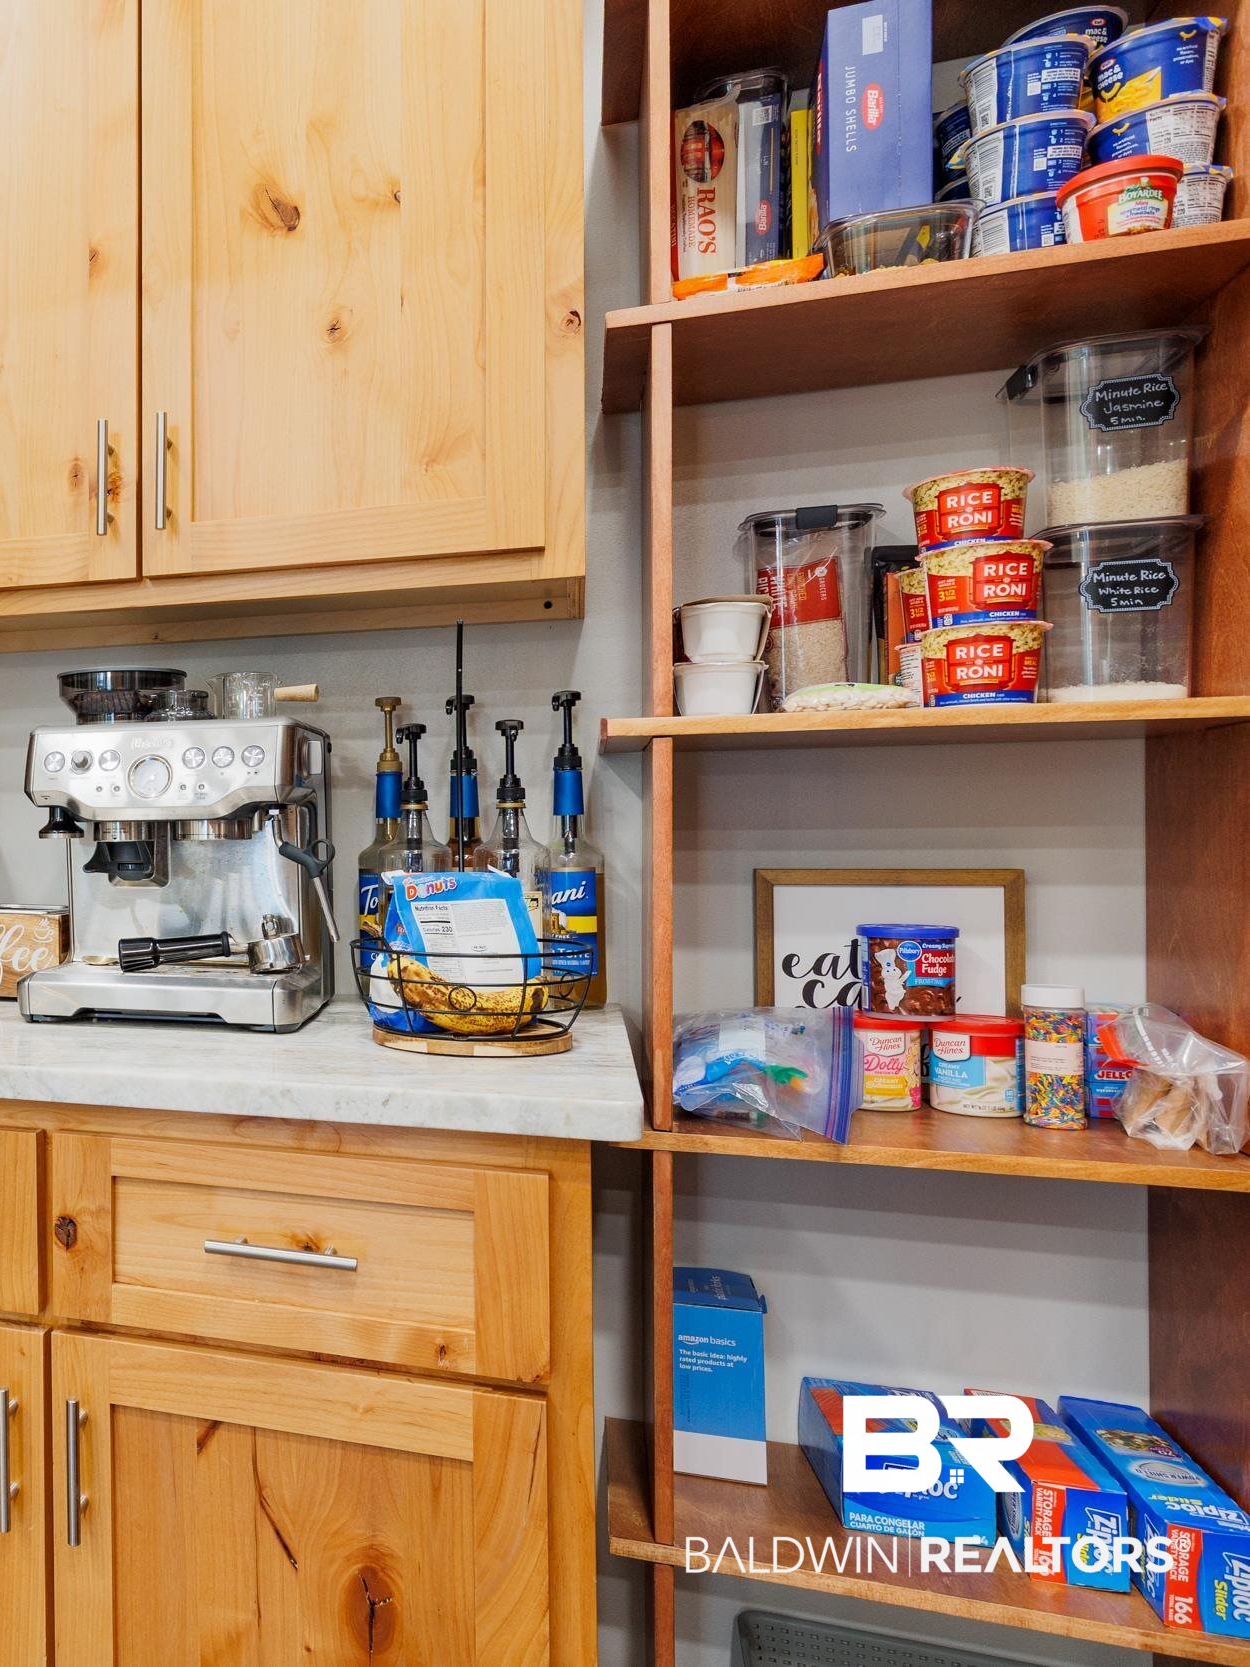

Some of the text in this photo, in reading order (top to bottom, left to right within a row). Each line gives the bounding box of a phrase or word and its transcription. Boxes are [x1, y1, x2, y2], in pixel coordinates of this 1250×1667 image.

[1098, 69, 1114, 80] mac
[845, 66, 857, 152] JUMBO SHELLS
[867, 89, 879, 126] Barilla
[1118, 189, 1163, 203] BOYARDEE
[688, 196, 696, 248] HOMEMADE
[697, 187, 716, 254] RAO'S
[758, 203, 767, 231] Barilla
[1096, 382, 1168, 402] Minute Rice
[1104, 400, 1164, 414] Jasmine
[1111, 417, 1118, 425] 5
[946, 491, 993, 508] RICE
[947, 511, 993, 528] RONI
[954, 538, 986, 546] CHICKEN
[984, 562, 1028, 577] RICE
[1093, 570, 1167, 583] Minute Rice
[758, 577, 768, 595] RIC
[983, 584, 1026, 598] RONI
[1098, 587, 1131, 595] White
[939, 591, 945, 601] 3
[1111, 598, 1117, 606] 5
[910, 609, 915, 618] 3
[956, 644, 1004, 659] RICE
[956, 665, 1003, 680] RONI
[404, 876, 456, 901] Donuts
[441, 925, 452, 933] 230
[899, 947, 920, 956] Pillsbury
[782, 939, 863, 979] eat
[922, 964, 947, 975] Fudge
[870, 1037, 902, 1046] Duncan
[876, 1042, 901, 1052] Hines
[934, 1038, 966, 1047] Duncan
[937, 1045, 963, 1055] Hines
[864, 1054, 905, 1074] Dolly
[934, 1068, 968, 1079] VANILLA
[678, 1334, 736, 1346] amazon basics
[697, 1359, 726, 1368] products
[727, 1354, 747, 1363] highly
[692, 1365, 713, 1373] prices.
[1035, 1488, 1044, 1536] VARIETY PACK
[1043, 1489, 1054, 1537] STORAGE
[1166, 1500, 1243, 1522] Ziploc
[850, 1512, 924, 1530] PARA CONGELAR
[850, 1521, 882, 1532] CUARTO
[884, 1526, 894, 1534] DE
[1213, 1580, 1228, 1620] Slider
[1174, 1596, 1193, 1624] 166
